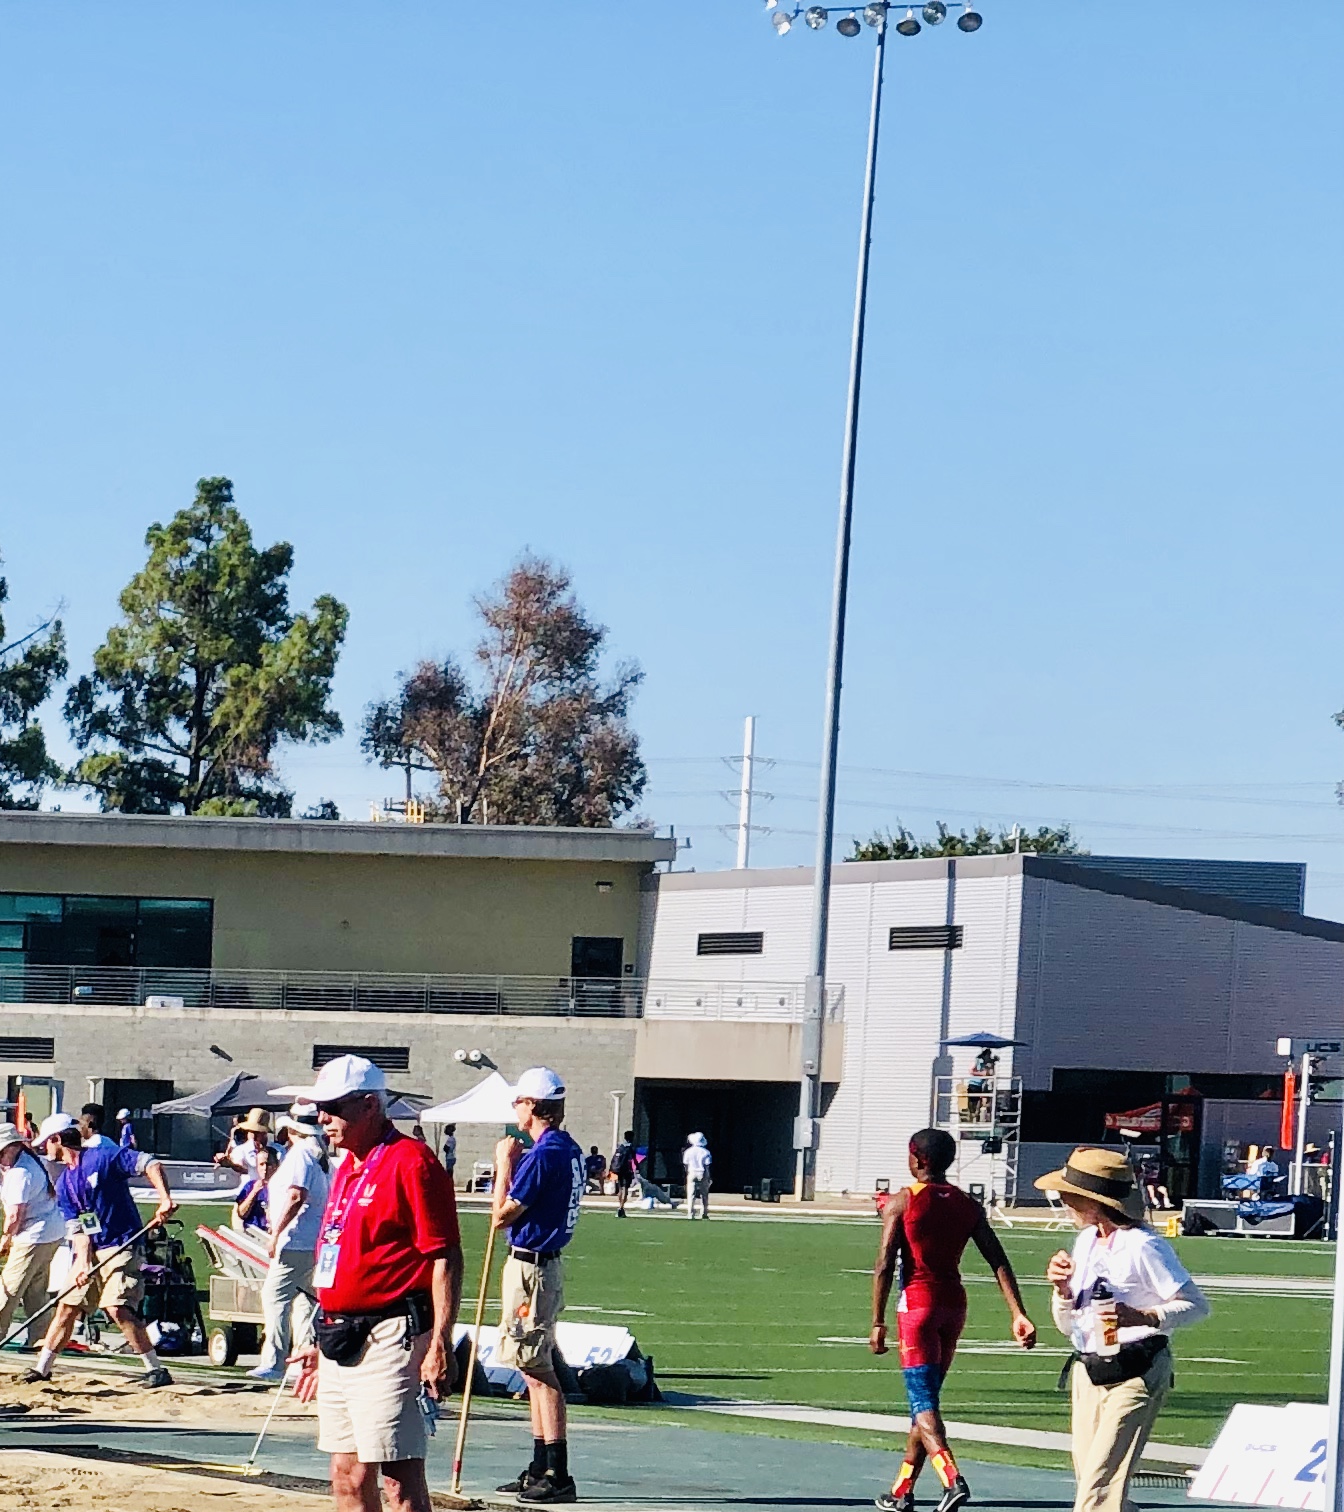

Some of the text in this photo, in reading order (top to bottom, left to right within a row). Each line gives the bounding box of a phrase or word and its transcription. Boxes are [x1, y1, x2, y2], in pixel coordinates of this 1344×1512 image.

[183, 1172, 215, 1181] UCS
[584, 1346, 613, 1364] 52
[1293, 1438, 1328, 1485] 2
